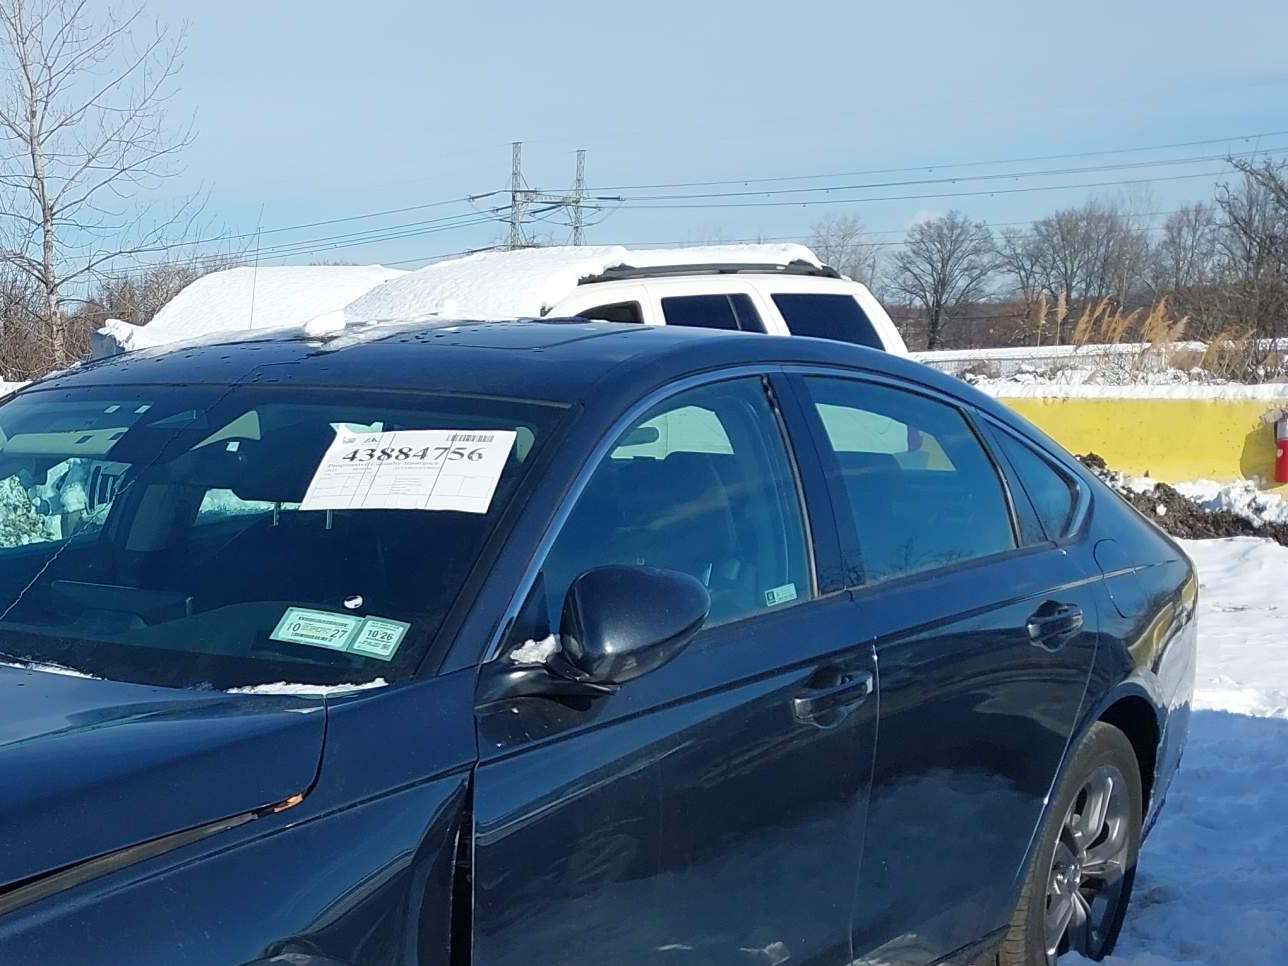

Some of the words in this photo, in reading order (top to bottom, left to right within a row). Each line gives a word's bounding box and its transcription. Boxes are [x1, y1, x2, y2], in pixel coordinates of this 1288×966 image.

[341, 446, 485, 462] 43884756
[287, 622, 302, 632] 10
[330, 628, 349, 639] 27
[367, 629, 379, 638] 10
[380, 631, 394, 641] 26
